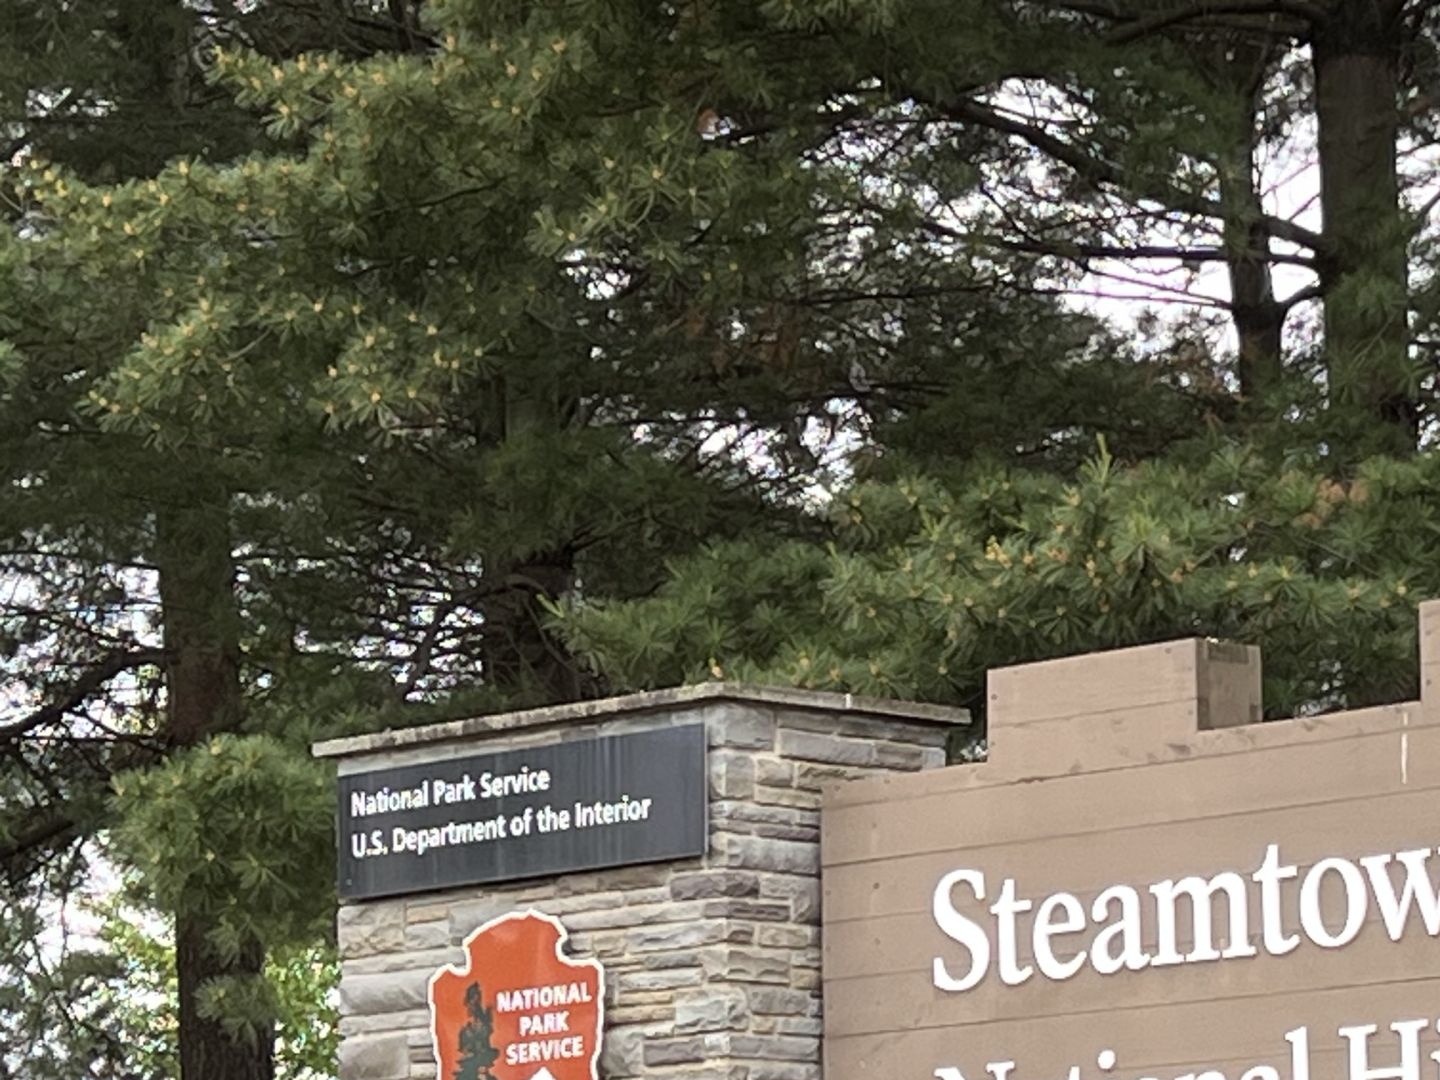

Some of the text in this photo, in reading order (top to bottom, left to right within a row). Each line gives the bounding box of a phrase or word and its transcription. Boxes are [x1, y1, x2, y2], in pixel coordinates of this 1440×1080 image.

[350, 766, 551, 817] National Park Service
[351, 794, 652, 858] U.S. Department of the Interior
[496, 982, 592, 1012] NATIONAL
[519, 1011, 569, 1036] PARK
[506, 1036, 584, 1065] SERVICE
